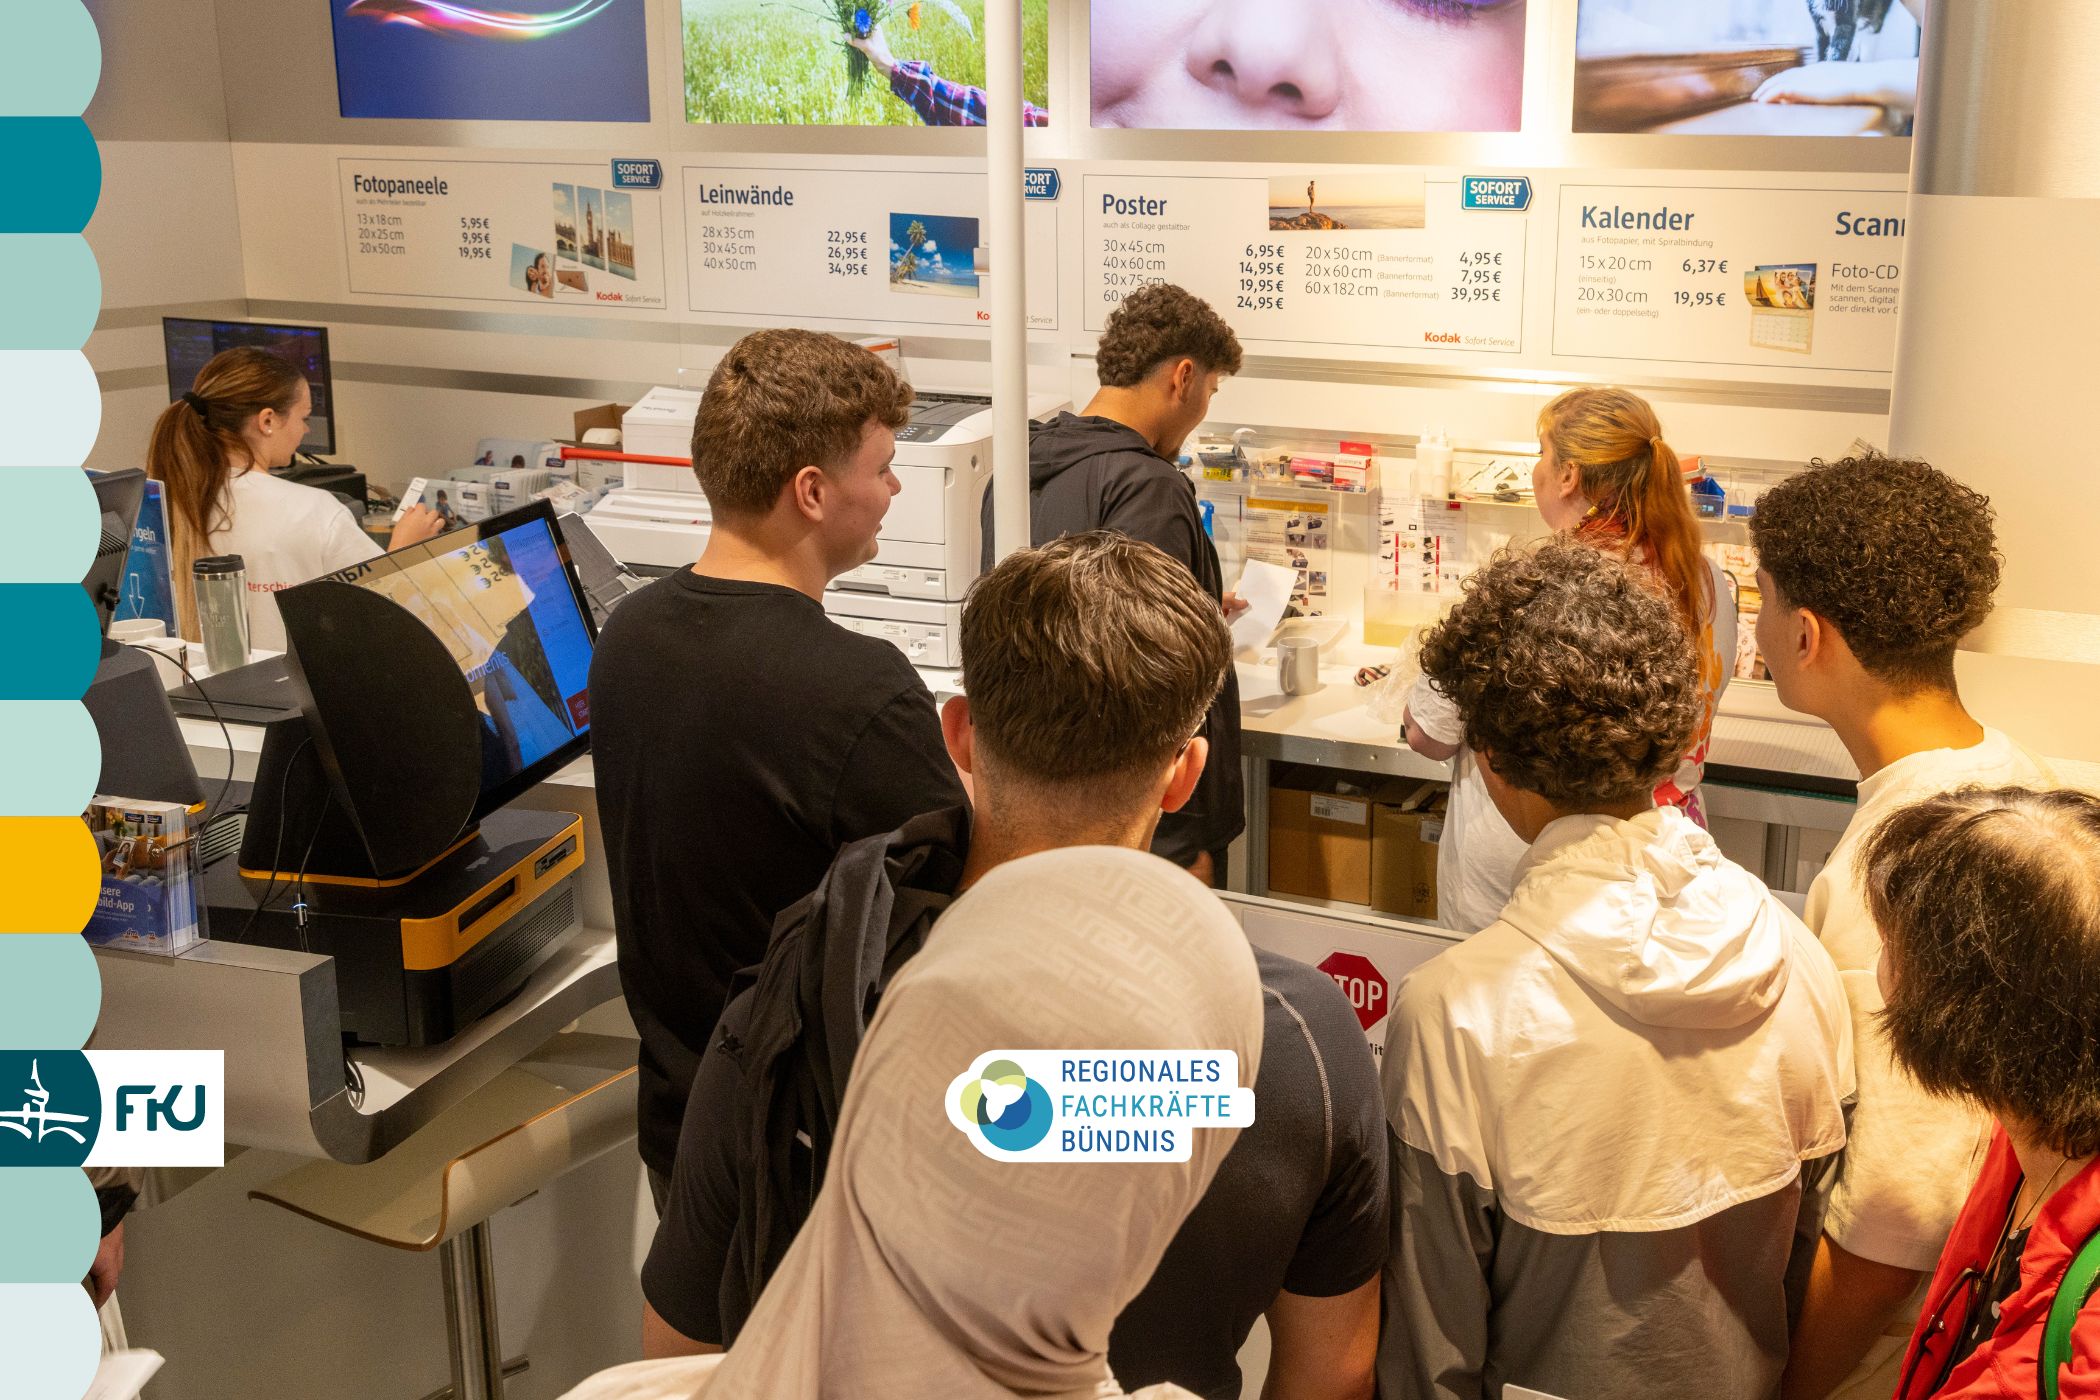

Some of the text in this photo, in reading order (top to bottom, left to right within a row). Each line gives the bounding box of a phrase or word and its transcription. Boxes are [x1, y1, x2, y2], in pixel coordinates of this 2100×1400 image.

[618, 164, 655, 174] SOFORT
[622, 176, 651, 184] SERVICE
[1024, 173, 1051, 184] FORT
[354, 175, 448, 197] Fotopaneele
[1024, 186, 1046, 194] RVICE
[1470, 182, 1522, 194] SOFORT
[700, 184, 794, 206] Leinwände
[1476, 195, 1515, 205] SERVICE
[1102, 194, 1167, 216] Poster
[1582, 206, 1694, 230] Kalender
[1132, 222, 1156, 231] Collage
[1658, 238, 1714, 248] Spiralbindung
[1378, 254, 1433, 264] (Bannerformat)
[1377, 272, 1432, 281] (Bannerformat)
[1832, 264, 1898, 279] Foto-CD
[1578, 276, 1616, 284] (einseitig)
[1830, 284, 1845, 292] Mit
[1846, 284, 1865, 292] dem
[596, 292, 624, 301] Kodak
[1384, 290, 1439, 300] (Bannerformat)
[1830, 296, 1896, 304] scannen, digital
[1612, 309, 1659, 318] doppelseitig)
[1829, 304, 1848, 312] oder
[1850, 305, 1874, 313] direkt
[1424, 332, 1514, 346] Kodak Sofort Service
[466, 652, 510, 682] oments
[1334, 974, 1382, 1010] TOP
